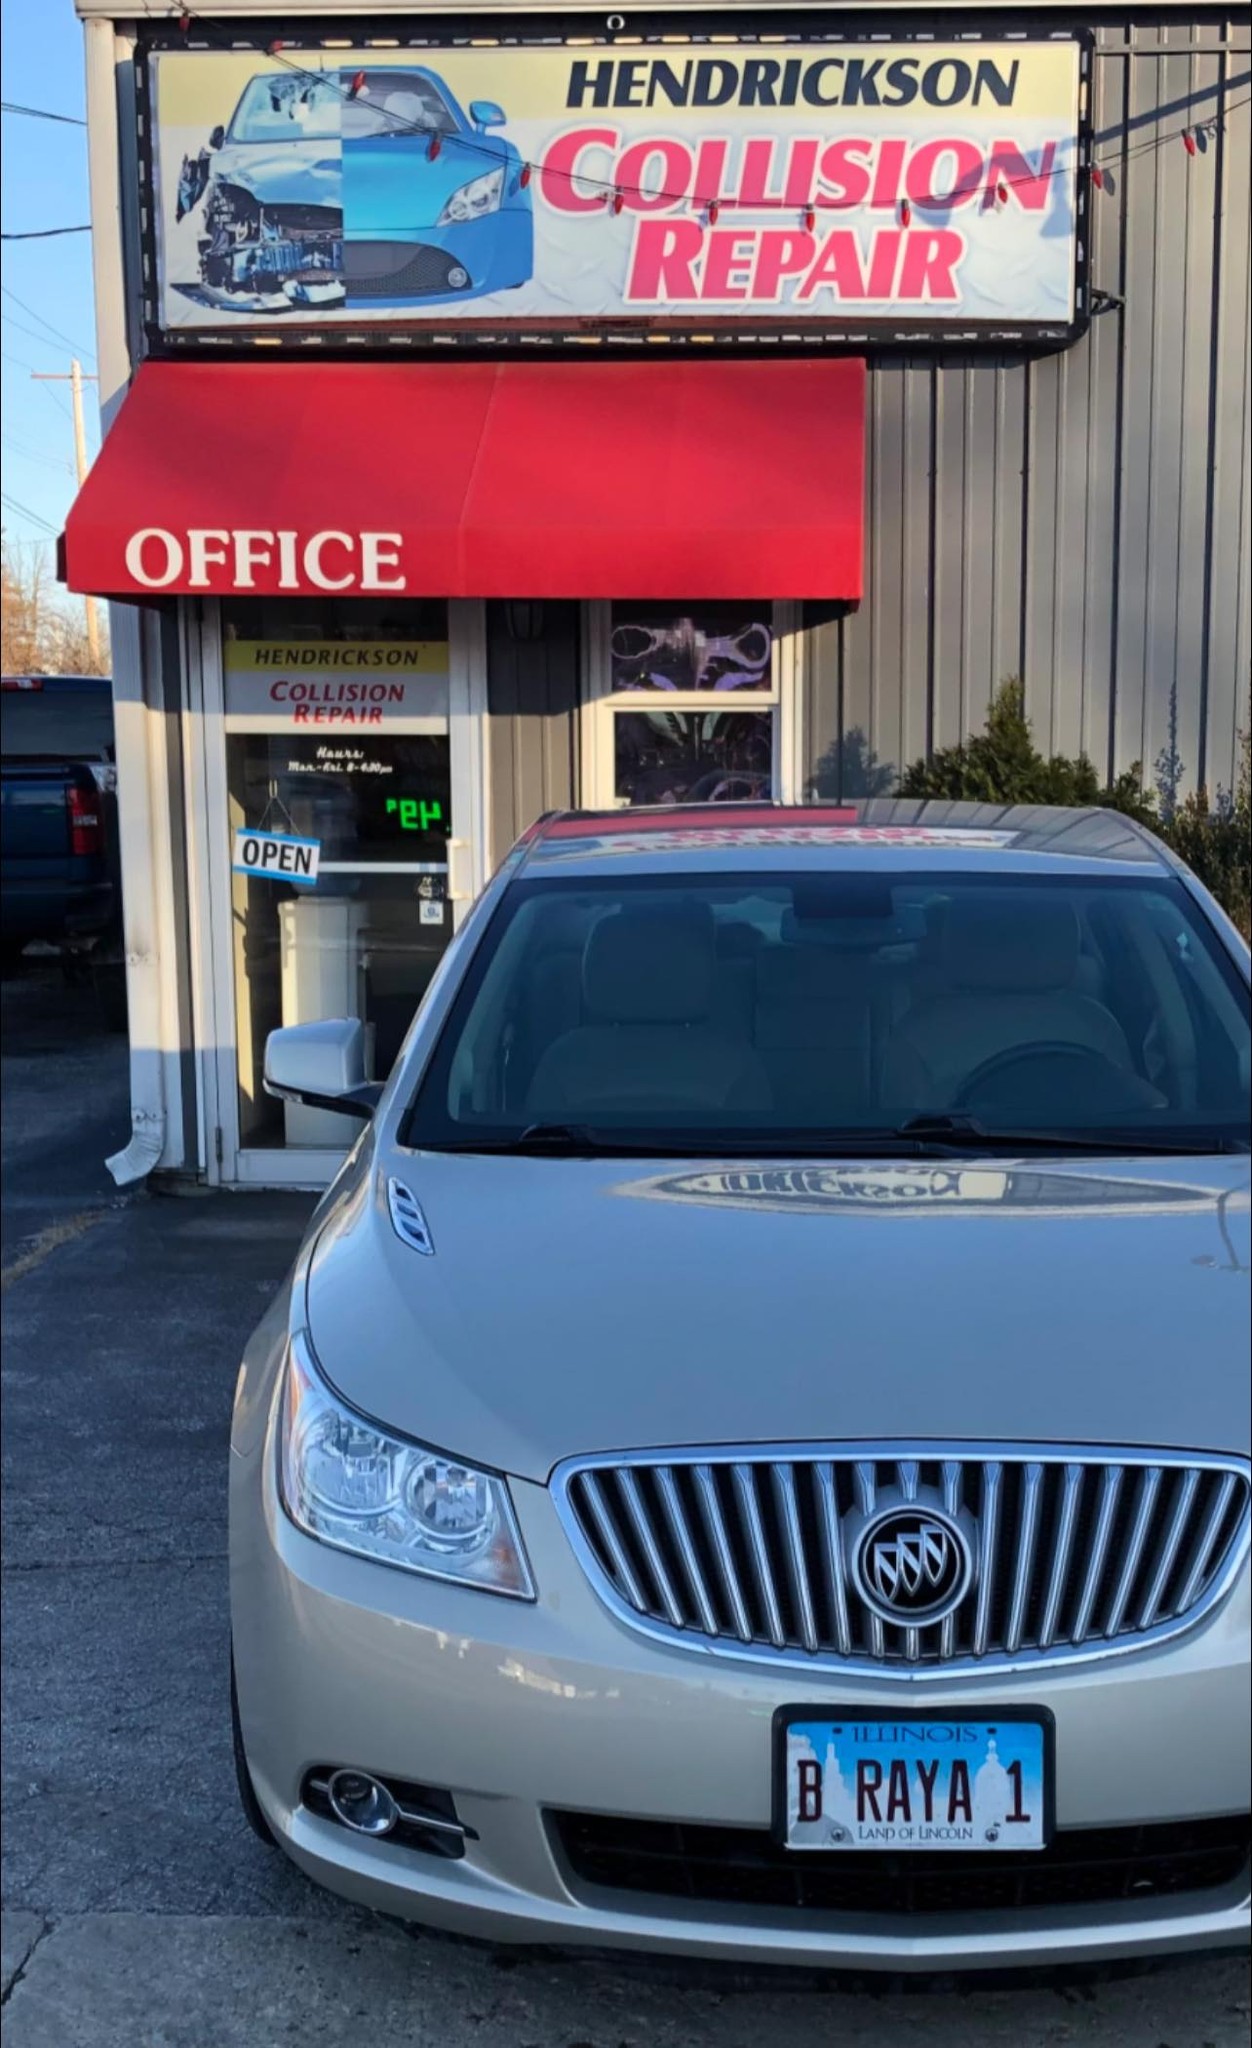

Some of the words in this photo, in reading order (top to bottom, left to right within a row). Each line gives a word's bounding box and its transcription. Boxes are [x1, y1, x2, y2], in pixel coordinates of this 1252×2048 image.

[566, 58, 1020, 109] HENDRICKSON
[540, 127, 1058, 212] COLLISION
[627, 219, 965, 301] REPAIR
[125, 527, 407, 590] OFFICE
[255, 649, 419, 666] HENDRICKSON
[270, 680, 406, 702] COLLISION
[293, 703, 383, 724] REPAIR
[242, 838, 312, 874] OPEN
[851, 1725, 978, 1743] ILLINOIS
[797, 1759, 822, 1823] B
[857, 1759, 973, 1823] RAYA
[1006, 1759, 1031, 1823] 1
[859, 1825, 895, 1841] LAND
[898, 1826, 914, 1840] OF
[918, 1825, 973, 1841] LINCOLN
